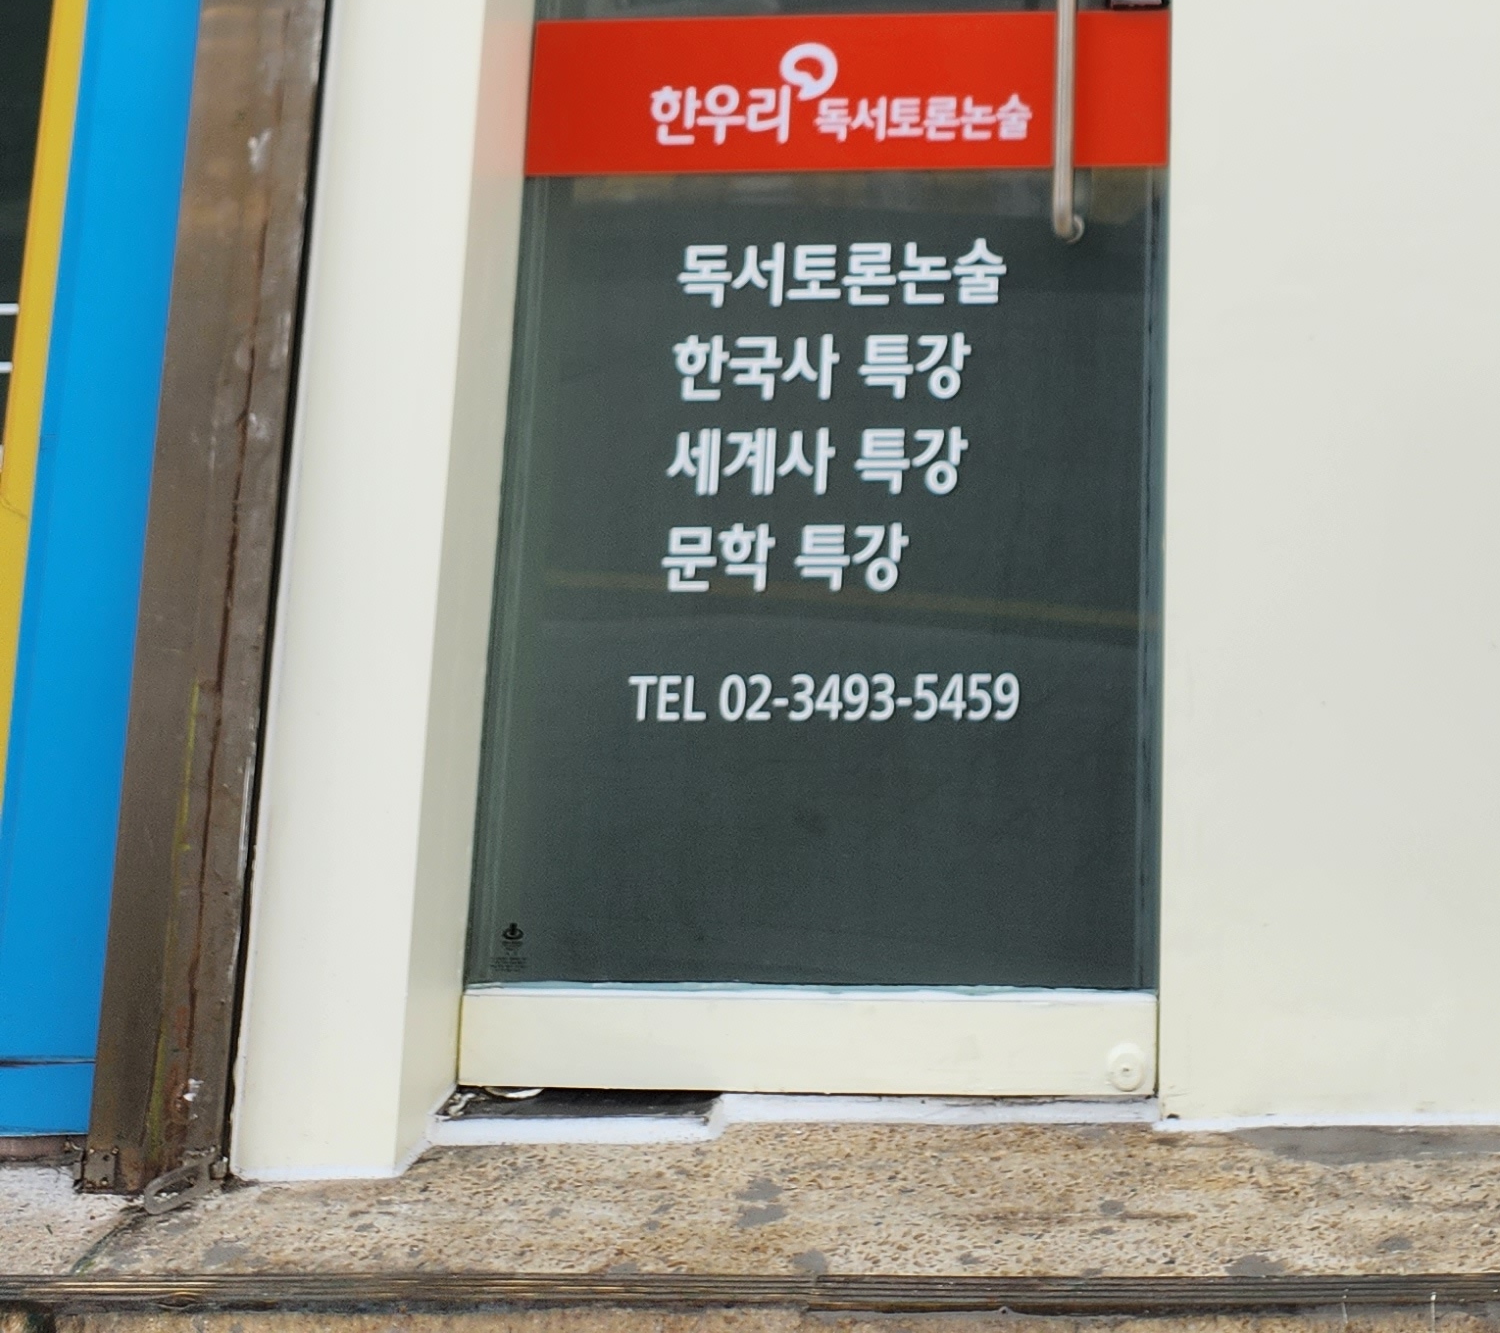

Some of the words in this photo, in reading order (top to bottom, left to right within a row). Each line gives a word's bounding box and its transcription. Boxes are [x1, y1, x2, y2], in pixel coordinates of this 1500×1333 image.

[650, 84, 792, 145] 한우리
[813, 93, 1033, 142] 독서토론논술
[676, 237, 1007, 309] 독서토론논술
[671, 332, 840, 401] 한국사
[857, 331, 972, 400] 특강
[665, 426, 836, 496] 세계사
[853, 425, 969, 496] 특강
[660, 521, 776, 593] 문학
[793, 521, 910, 593] 특강
[627, 674, 708, 722] TEL
[718, 671, 1021, 723] 02-3493-5459
